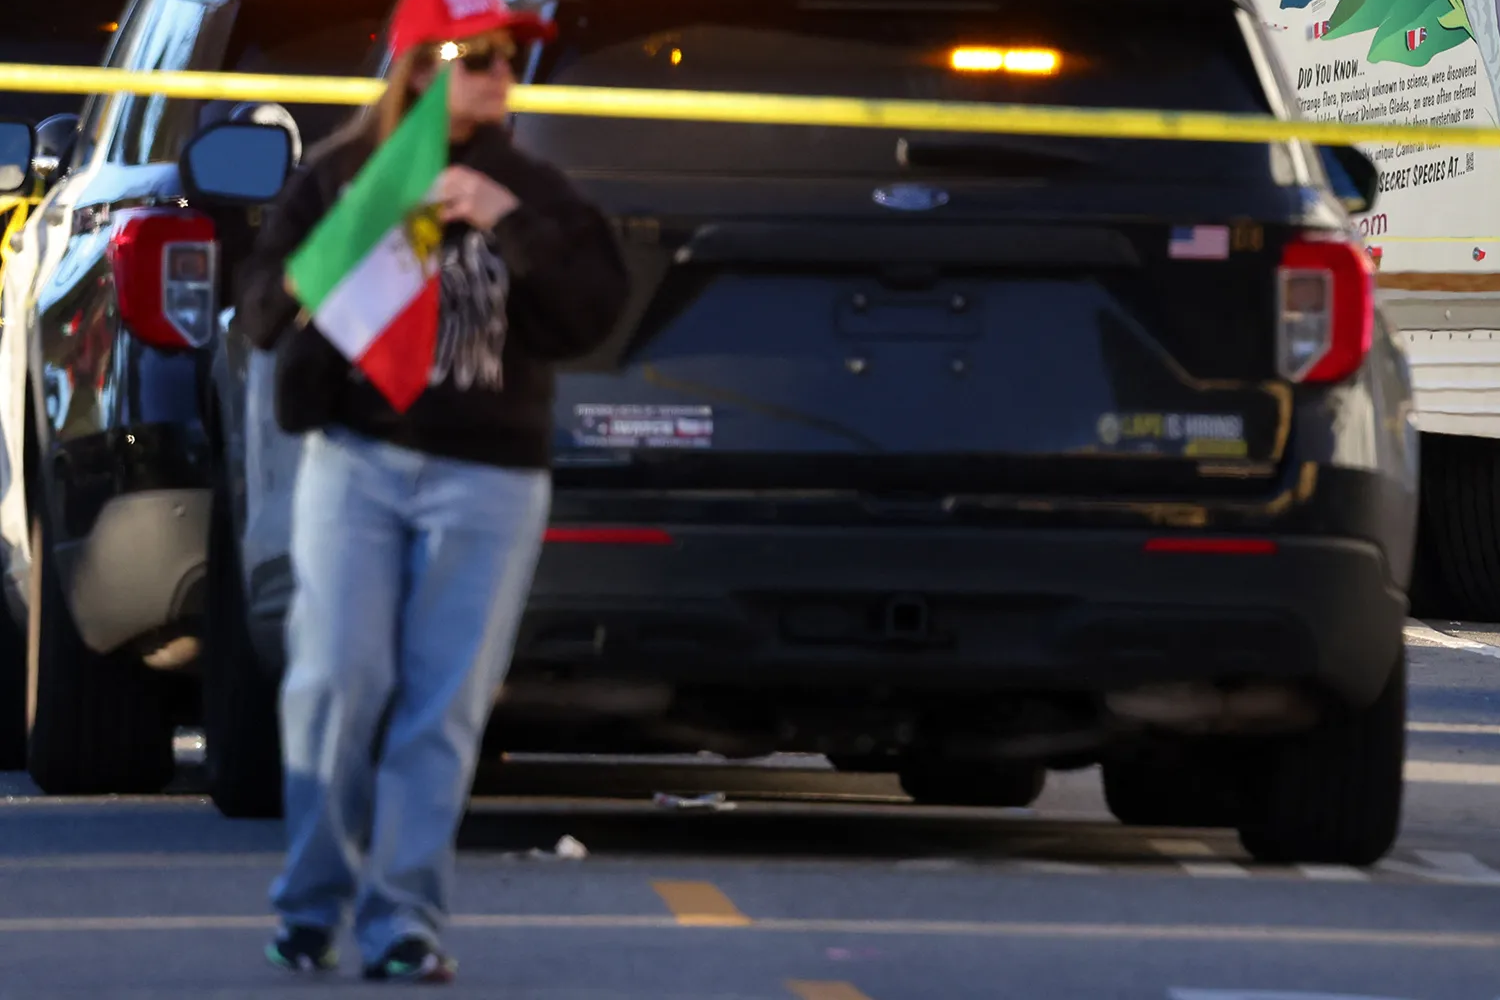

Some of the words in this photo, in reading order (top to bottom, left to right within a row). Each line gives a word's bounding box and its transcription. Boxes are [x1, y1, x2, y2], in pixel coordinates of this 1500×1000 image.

[1323, 91, 1339, 108] flora,
[1341, 82, 1370, 107] previously
[1372, 80, 1398, 98] unknown
[1399, 77, 1406, 92] to
[1407, 74, 1430, 91] science,
[1432, 70, 1446, 84] were
[1447, 59, 1477, 81] discovered
[1361, 103, 1388, 122] Dolomite
[1389, 98, 1412, 116] Glades,
[1414, 100, 1421, 109] an
[1423, 95, 1435, 107] area
[1437, 89, 1452, 104] often
[1454, 81, 1477, 99] referred
[1430, 110, 1461, 128] mysterious
[1463, 107, 1475, 121] rare
[1379, 167, 1412, 193] SECRET
[1413, 160, 1446, 186] SPECIES
